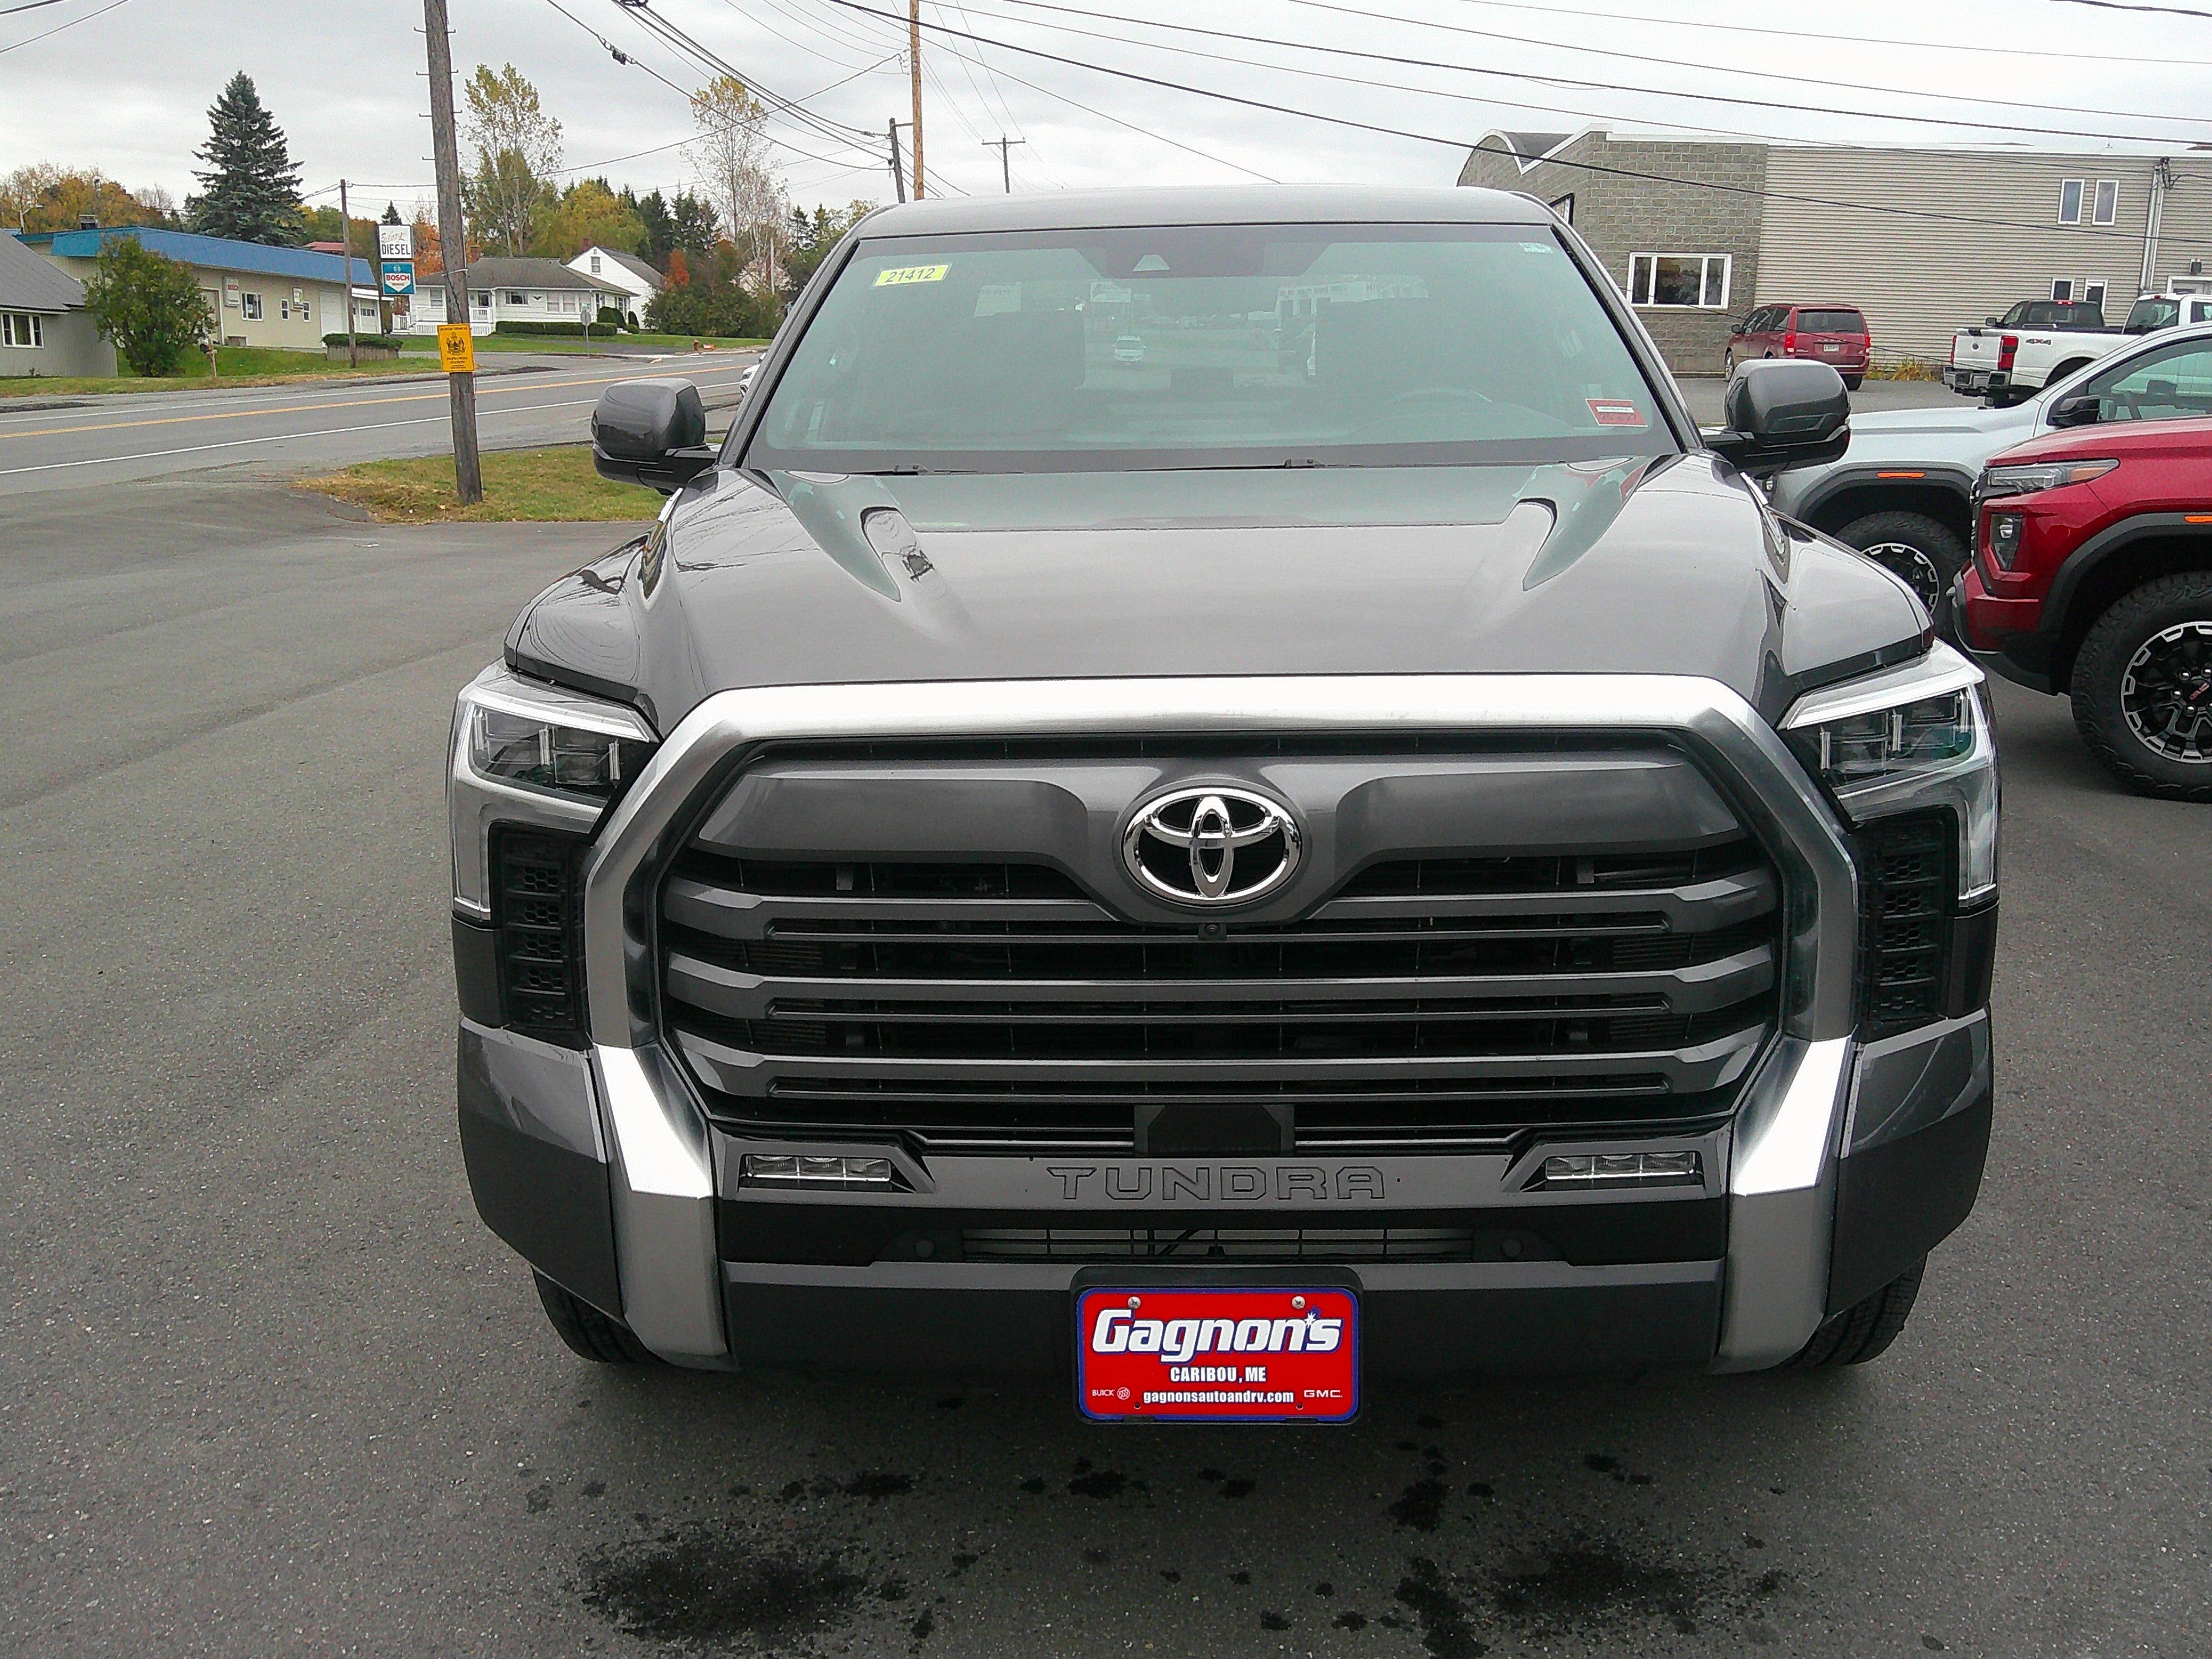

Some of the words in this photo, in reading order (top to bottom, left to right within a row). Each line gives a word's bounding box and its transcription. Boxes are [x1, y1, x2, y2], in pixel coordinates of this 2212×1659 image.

[382, 244, 410, 255] DIESEL
[885, 268, 936, 283] 21412
[1046, 1166, 1386, 1200] TUNDRA
[1092, 1307, 1342, 1363] Gagnon's
[1245, 1366, 1267, 1383] ME
[1143, 1390, 1294, 1404] gagnonsautoandrv.com
[1303, 1390, 1343, 1399] GMC
